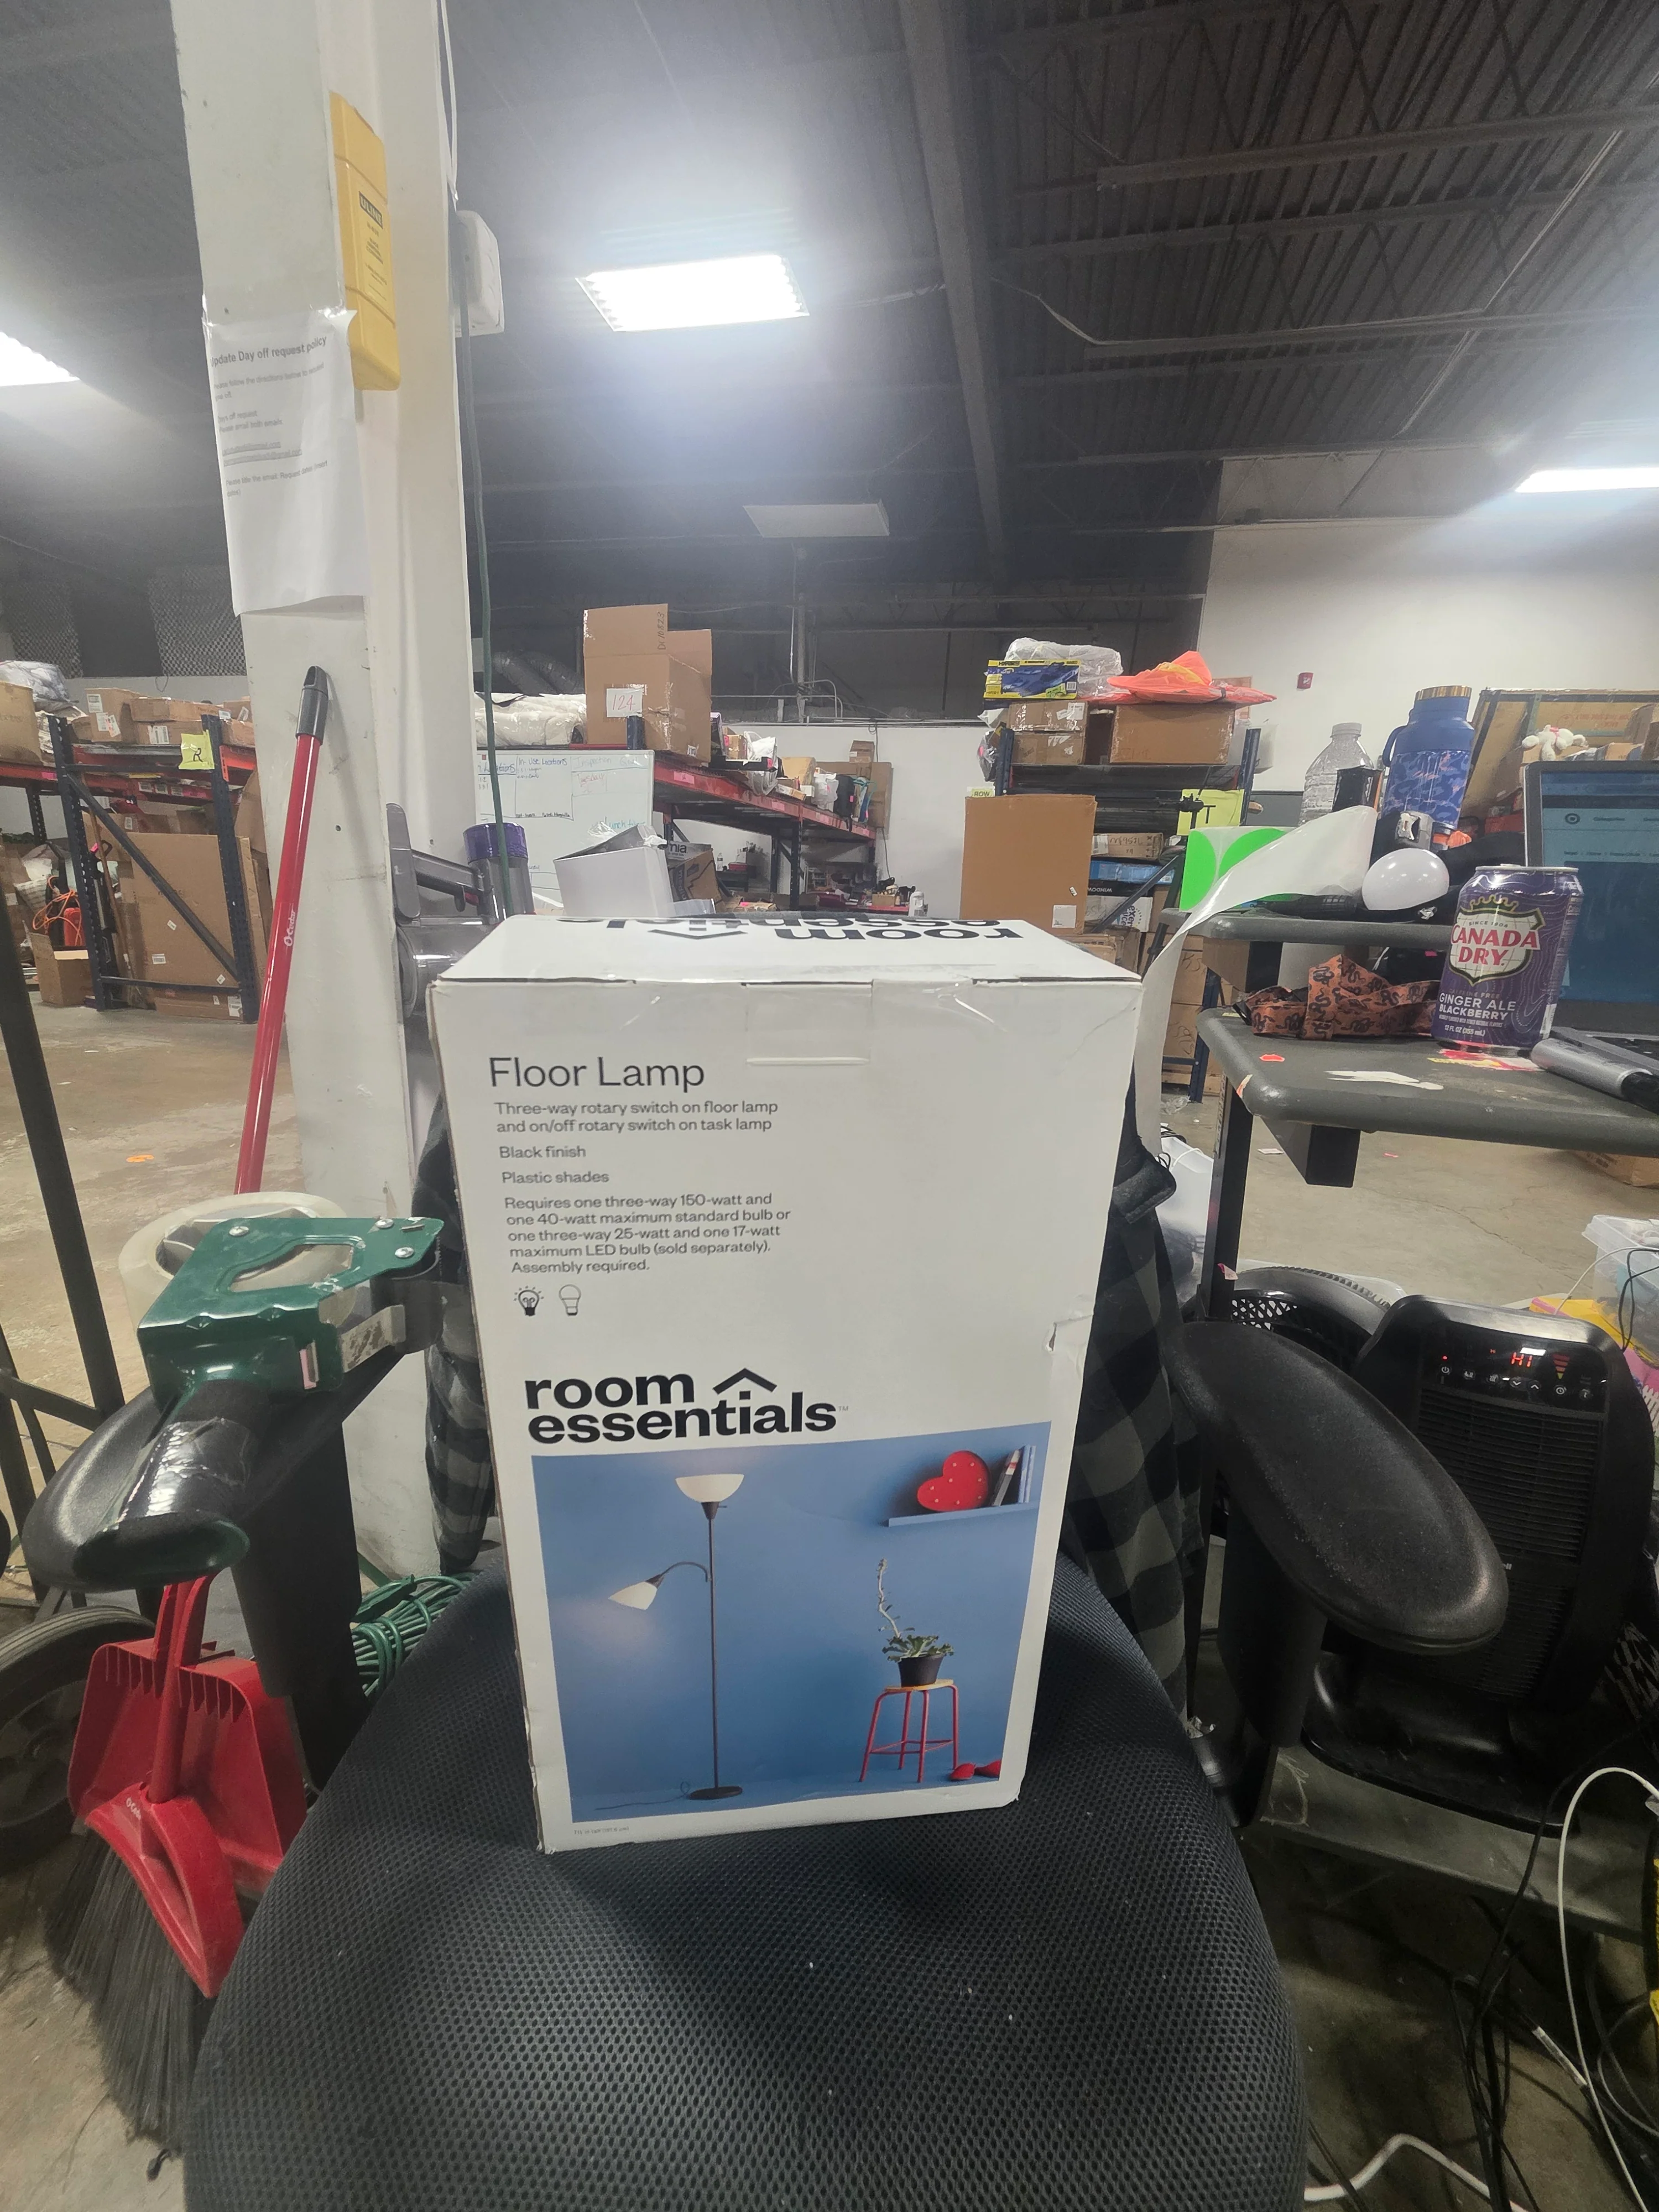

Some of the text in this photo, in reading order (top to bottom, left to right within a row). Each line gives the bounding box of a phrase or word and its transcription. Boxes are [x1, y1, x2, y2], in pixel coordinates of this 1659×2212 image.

[238, 349, 254, 363] Day
[257, 347, 270, 359] off
[271, 345, 306, 358] request
[306, 336, 327, 354] policy
[612, 694, 636, 711] 124
[192, 747, 204, 763] R
[775, 928, 1024, 940] room
[1451, 924, 1538, 948] CANADA
[1439, 993, 1516, 1011] GINGER ALE
[1439, 1004, 1509, 1020] BLACKBERRY
[489, 1056, 705, 1093] Floor Lamp
[494, 1100, 778, 1117] Three-way rotary switch on floor lamp
[497, 1118, 772, 1134] and on/off rotary switch on task lamp
[499, 1145, 586, 1159] Black finish
[502, 1169, 609, 1184] Plastic shades
[504, 1193, 772, 1211] Requires one three-way 150-watt and
[506, 1209, 791, 1225] one 40-watt maximum standard bulb or
[508, 1225, 781, 1243] one three-way 25-watt and one 17-watt
[510, 1240, 771, 1258] maximum LED bulb (sold separately).
[511, 1259, 650, 1275] Assembly required.
[1511, 1352, 1532, 1368] HI
[524, 1374, 695, 1410] room
[528, 1391, 837, 1444] essentials
